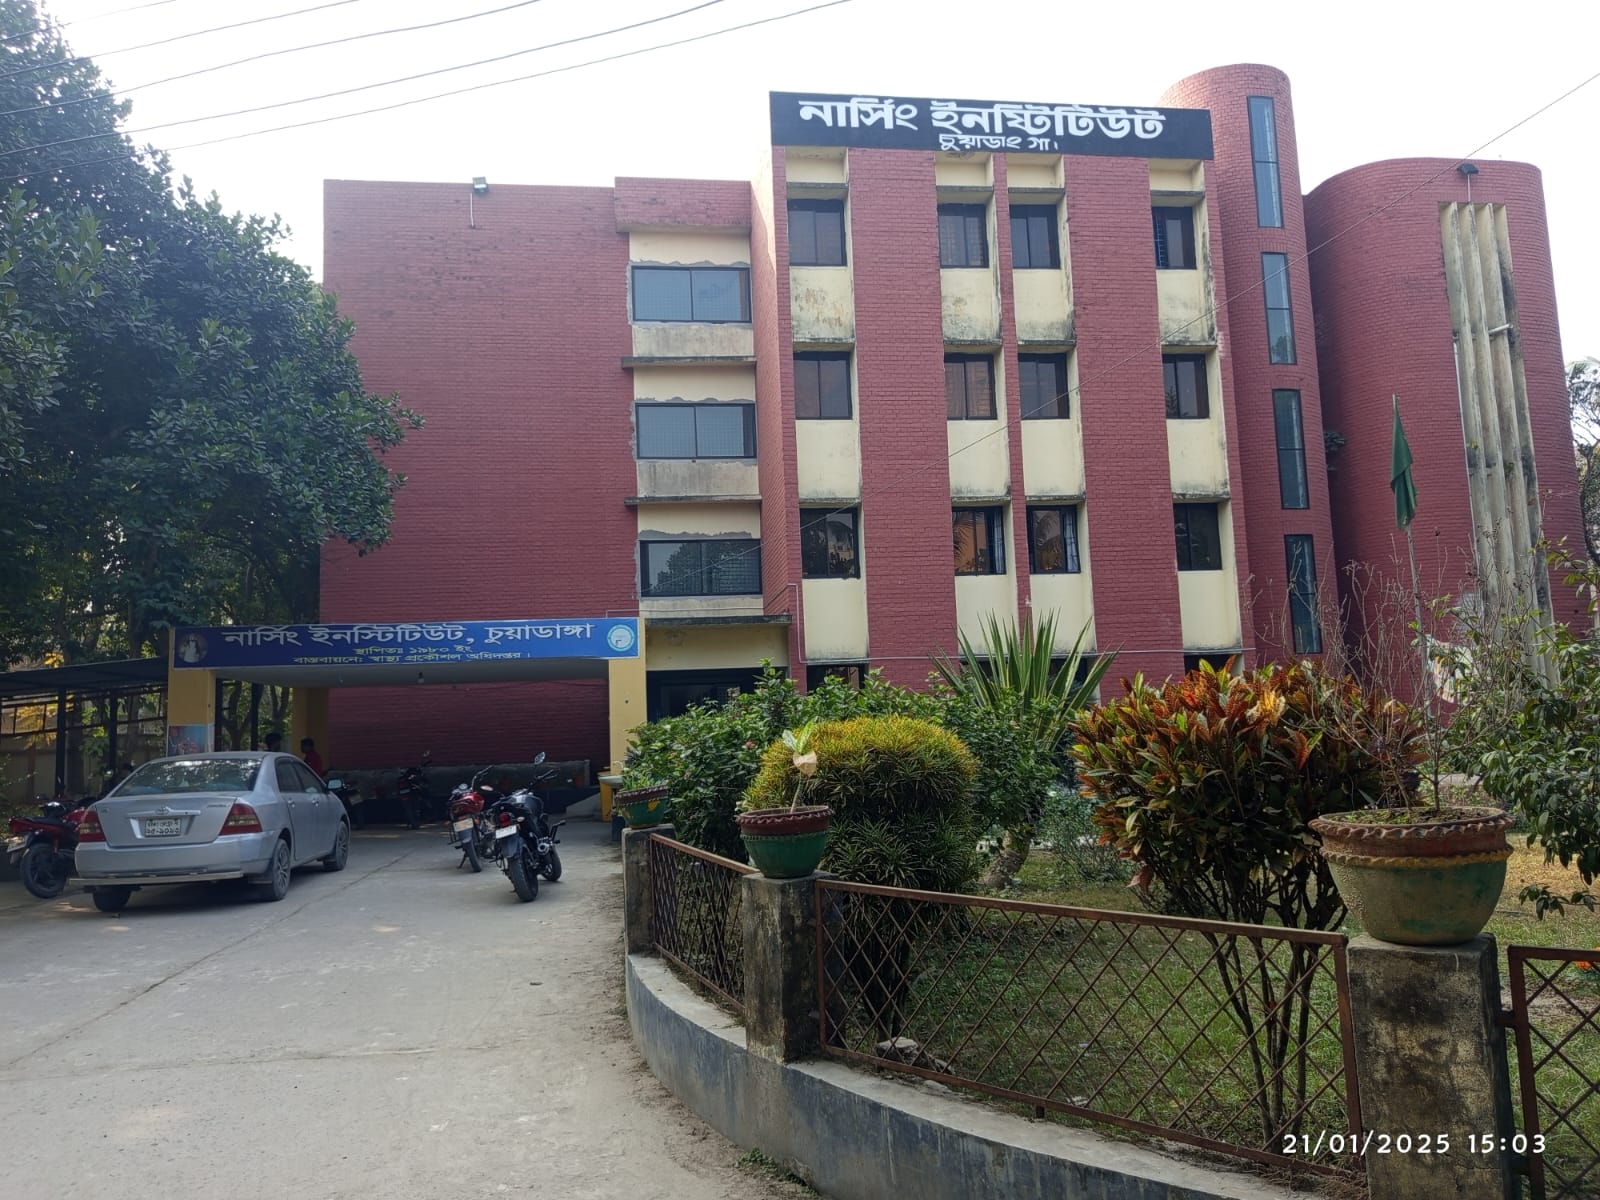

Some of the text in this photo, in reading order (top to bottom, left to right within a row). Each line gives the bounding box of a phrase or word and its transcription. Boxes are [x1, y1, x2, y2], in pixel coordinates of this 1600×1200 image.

[798, 97, 919, 131] নার্সিং
[221, 625, 303, 647] নার্সিং
[484, 623, 596, 645] চুয়াডাঙ্গা
